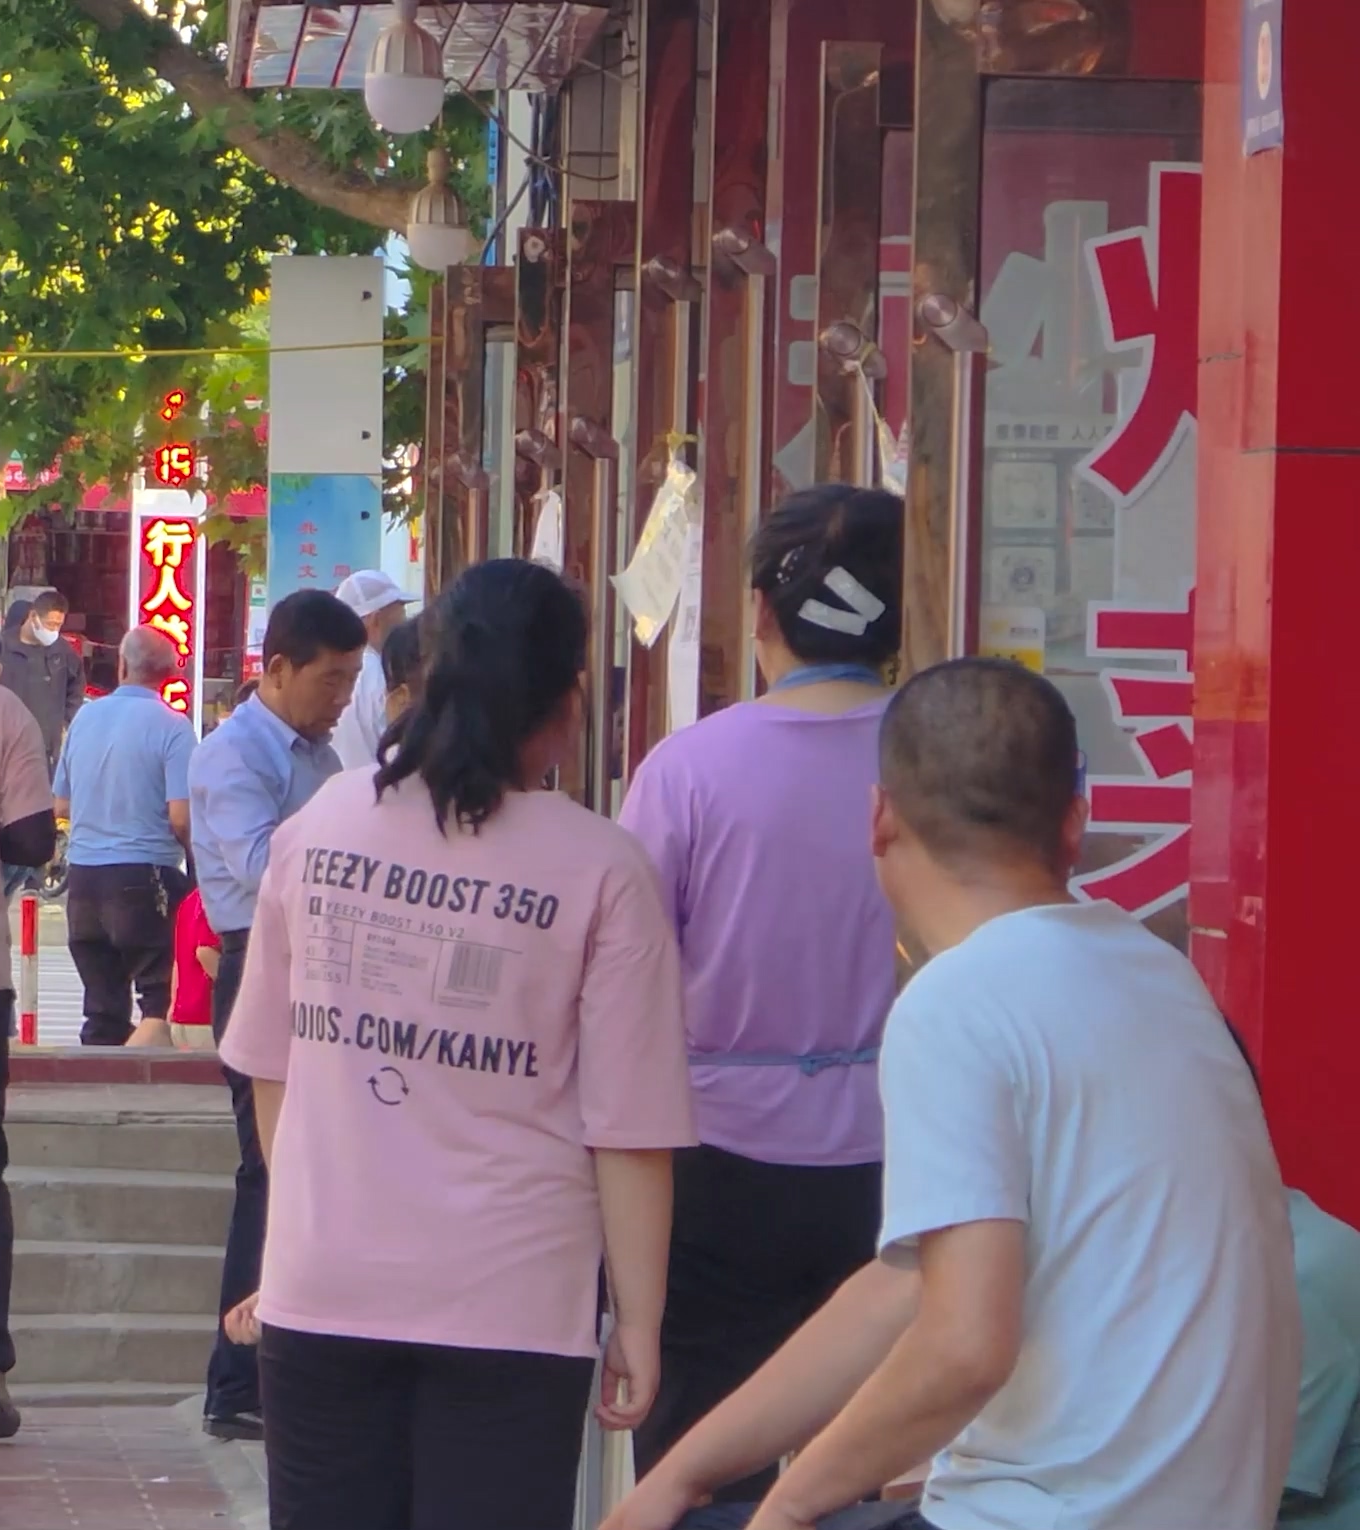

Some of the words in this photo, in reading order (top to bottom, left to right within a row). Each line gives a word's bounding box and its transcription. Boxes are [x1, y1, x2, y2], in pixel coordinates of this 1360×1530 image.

[302, 847, 382, 894] YEEZY
[383, 863, 491, 914] BOOST
[493, 883, 560, 930] 350
[326, 902, 366, 919] YEEZY
[370, 911, 412, 930] BOOST
[419, 921, 444, 937] 350
[448, 926, 465, 940] V2
